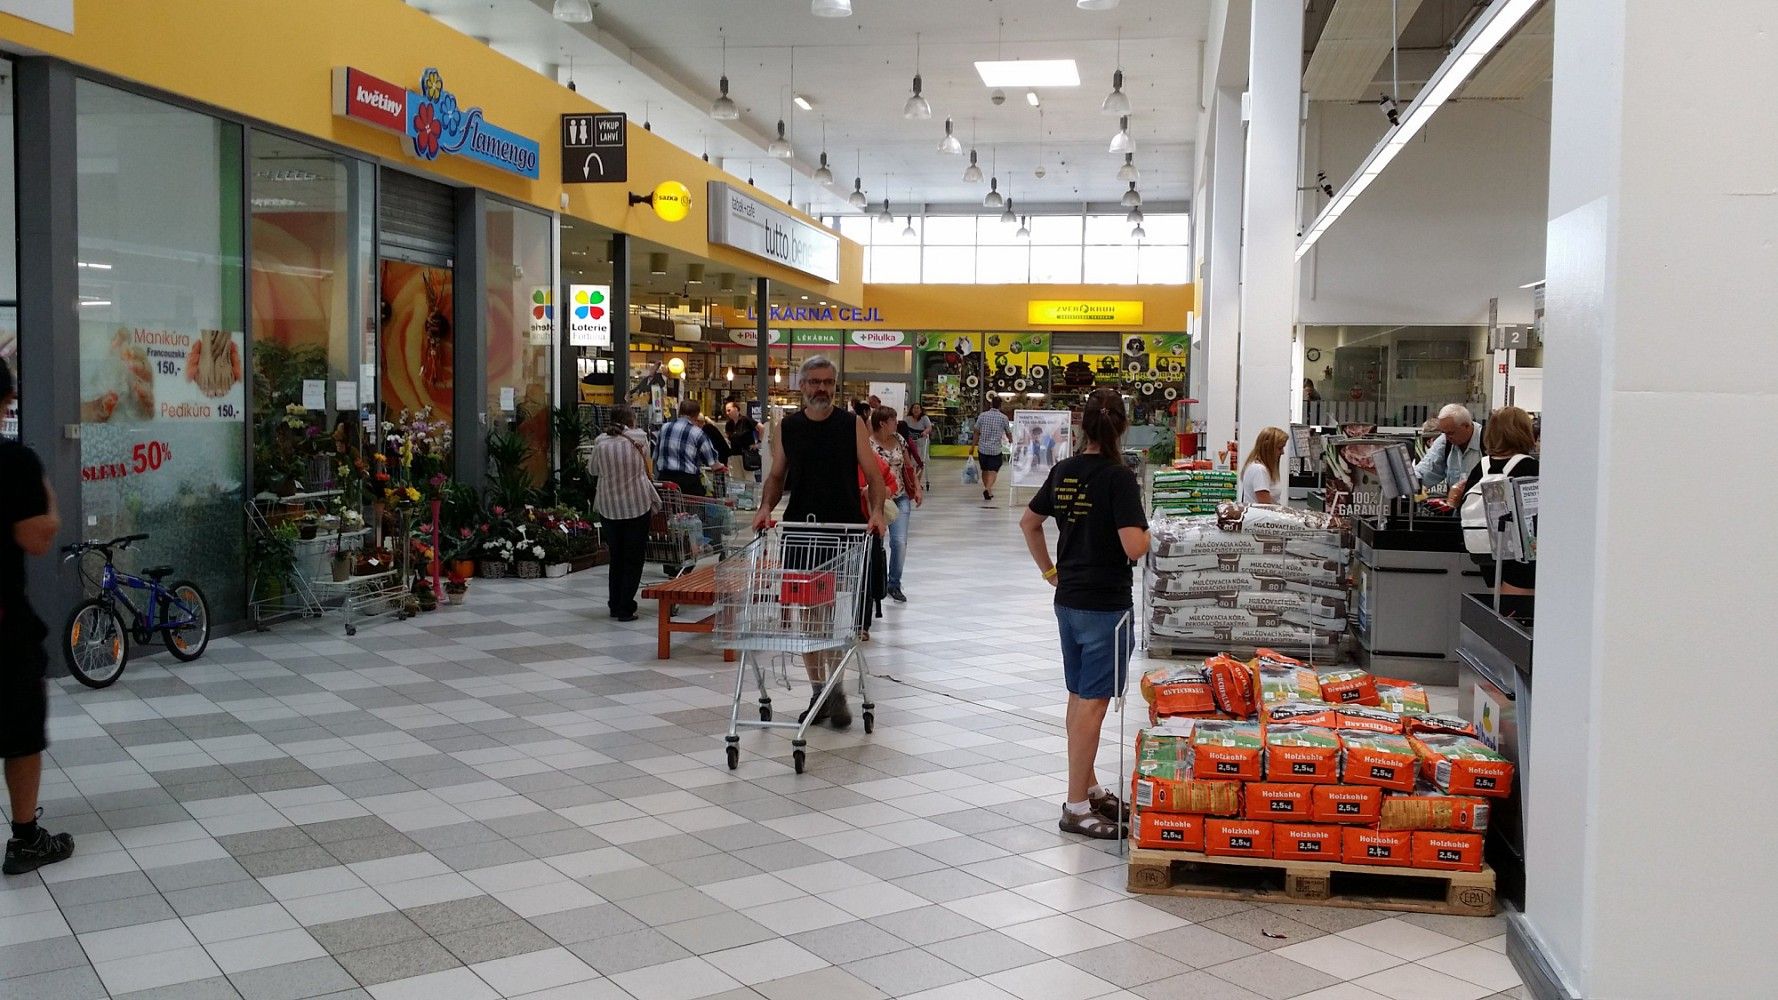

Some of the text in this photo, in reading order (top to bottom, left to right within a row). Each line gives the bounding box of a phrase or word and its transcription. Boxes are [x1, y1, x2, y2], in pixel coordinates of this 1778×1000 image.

[356, 85, 402, 117] květiny
[599, 121, 620, 131] VÝKUP
[600, 131, 619, 142] LAHVÍ
[765, 219, 789, 260] tutto
[748, 304, 884, 322] LKÁRNA CEJL
[572, 323, 607, 332] Loterie
[135, 328, 190, 347] Manikúra
[1511, 332, 1520, 343] 2
[157, 361, 181, 376] 150,-
[161, 402, 240, 419] Pedikúra 150,-
[82, 441, 172, 481] SLEVA 50%
[1351, 492, 1378, 504] 100%
[1339, 503, 1391, 516] GARANCE
[1250, 562, 1284, 570] MULČOVAC
[1209, 752, 1248, 761] Holzkohle
[1284, 752, 1324, 761] Holzkohle
[1364, 756, 1403, 768] Holzkohle
[1218, 764, 1238, 772] 2,5kg
[1294, 764, 1314, 772] 2,5kg
[1468, 767, 1504, 776] Holzkohle
[1372, 768, 1392, 778] 2,5kg
[1475, 778, 1494, 787] 2,5kg
[1262, 790, 1301, 798] Holzkohle
[1329, 793, 1368, 801] Holzkohle
[1271, 802, 1292, 810] 2,5kg
[1338, 804, 1359, 812] 2,5kg
[1153, 819, 1192, 828] Holzkohle
[1162, 831, 1182, 839] 2,5kg
[1222, 827, 1260, 835] Holzkohle
[1290, 830, 1329, 839] Holzkohle
[1231, 838, 1250, 847] 2,5kg
[1359, 835, 1399, 845] Holzkohle
[1430, 839, 1470, 848] Holzkohle
[1299, 842, 1319, 850] 2,5kg
[1439, 851, 1459, 860] 2,5kg
[1464, 892, 1485, 903] EPAL
